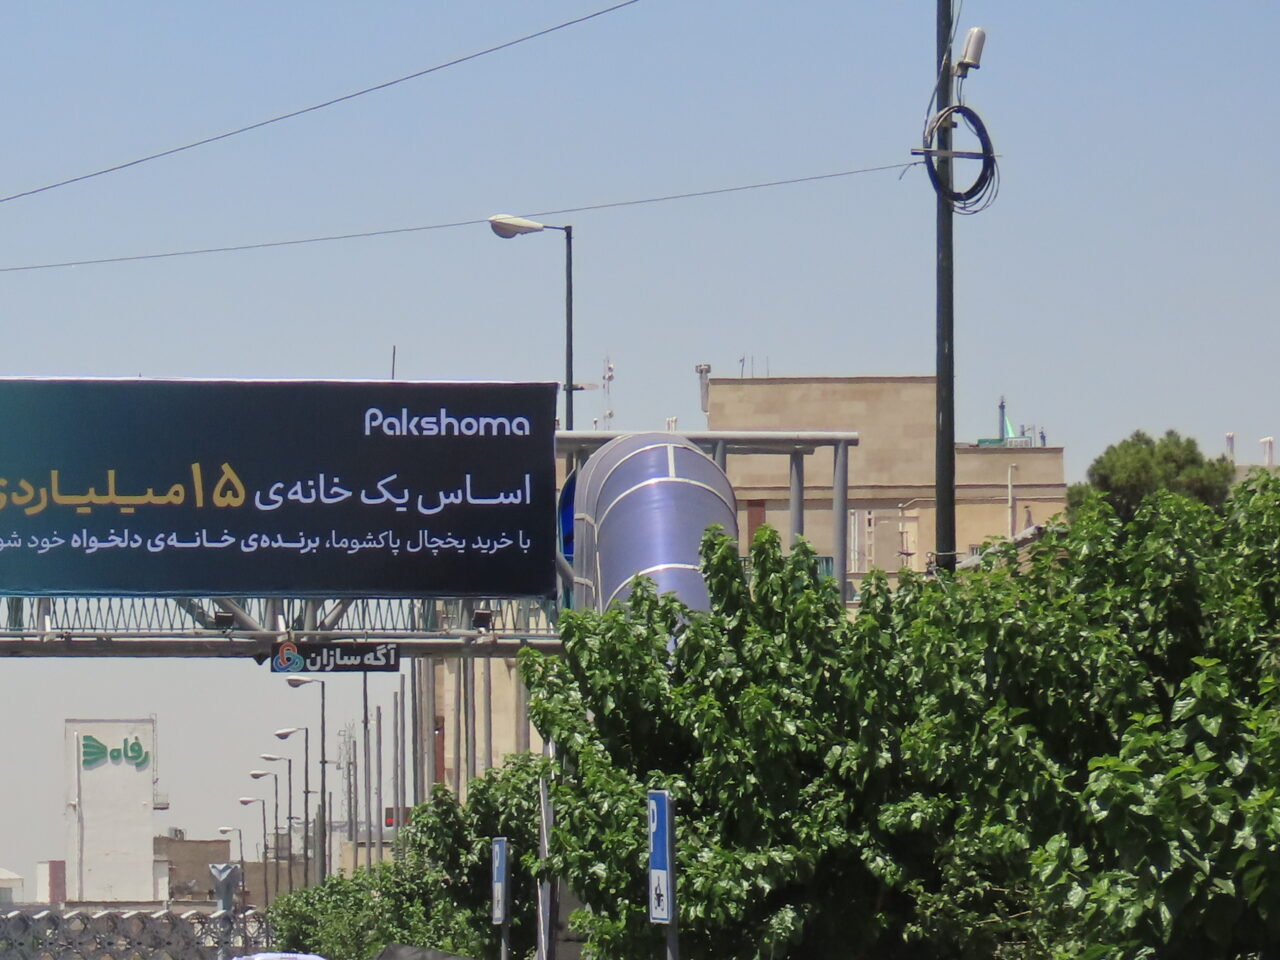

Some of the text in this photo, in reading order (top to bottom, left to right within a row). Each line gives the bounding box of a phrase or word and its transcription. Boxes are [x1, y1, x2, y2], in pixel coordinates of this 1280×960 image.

[364, 408, 530, 436] Pakshoma
[360, 474, 410, 511] یک
[417, 474, 531, 514] اساس
[27, 531, 66, 553] خود
[70, 529, 142, 554] دلخواه
[406, 530, 467, 556] یخچال
[471, 531, 514, 553] خرید
[519, 530, 531, 553] با
[305, 643, 398, 671] آگه سازان
[109, 736, 149, 768] رفاه
